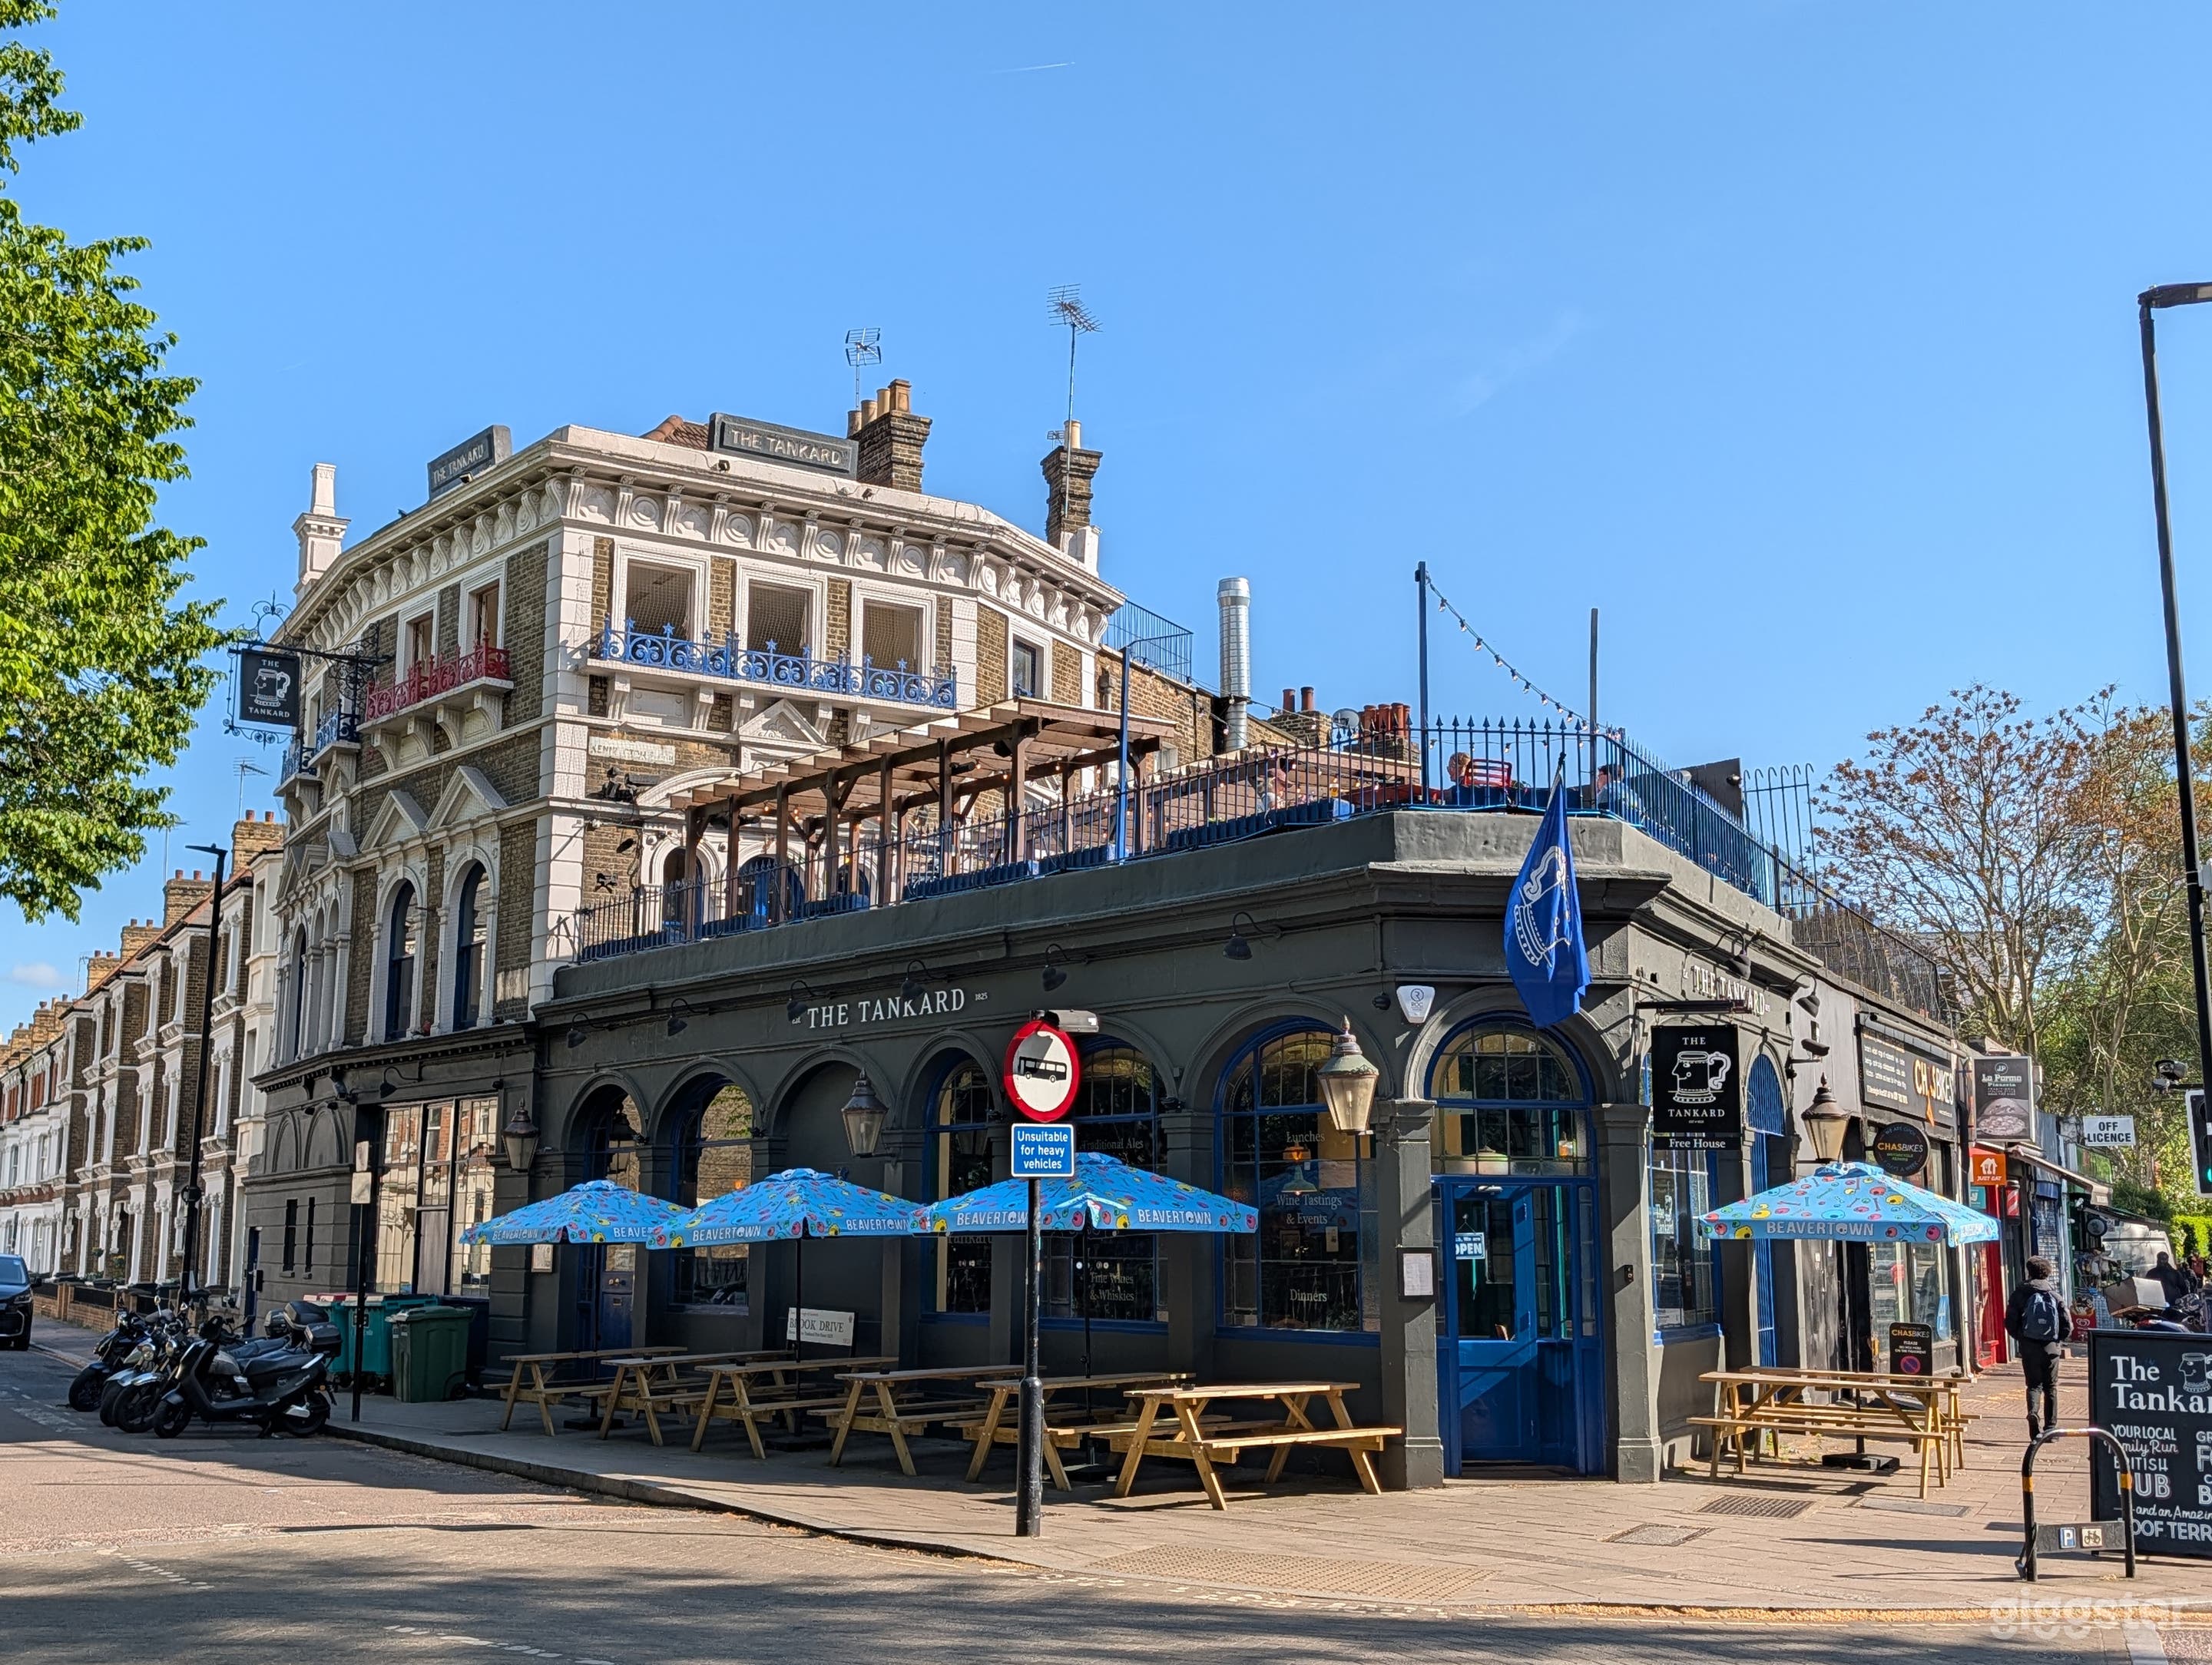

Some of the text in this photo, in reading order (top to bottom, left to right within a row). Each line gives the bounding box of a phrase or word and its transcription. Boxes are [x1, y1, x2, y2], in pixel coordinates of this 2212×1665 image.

[731, 429, 842, 465] THE TANKARD
[433, 444, 484, 486] THE TANKARD
[261, 659, 280, 668] THE
[248, 707, 290, 718] TANKARD
[1694, 965, 1764, 1015] THE TANKARD
[807, 1004, 849, 1028] THE
[858, 988, 965, 1023] TANKARD
[1682, 1037, 1706, 1045] THE
[1668, 1108, 1725, 1117] TANKARD
[2098, 1121, 2118, 1131] OFF
[1017, 1130, 1068, 1142] Unsuitable
[1286, 1130, 1326, 1143] Lunches
[2087, 1133, 2132, 1143] LICENCE
[1126, 1137, 1144, 1149] Ales
[1669, 1138, 1726, 1148] Free House
[1877, 1142, 1923, 1153] CHASBIKES
[1021, 1144, 1065, 1157] for heavy
[1024, 1158, 1061, 1170] vehicles
[1276, 1194, 1343, 1210] Wine Tastings
[956, 1211, 1028, 1226] BEAVERTOW
[1137, 1209, 1212, 1225] BEAVERTOWN
[1286, 1213, 1328, 1224] & Events
[846, 1218, 909, 1231] BEAVERTOWN
[1767, 1221, 1874, 1236] BEAVERTOWN
[692, 1225, 761, 1242] BEAVERTOWN
[1098, 1289, 1135, 1302] Whiskies
[1290, 1289, 1328, 1303] Dinners
[820, 1320, 845, 1333] DRIVE
[1891, 1329, 1930, 1339] CHASBIKES
[2110, 1356, 2161, 1382] The
[2111, 1424, 2177, 1441] YOUR LOCAL
[2104, 1438, 2178, 1457] mily Run
[2114, 1455, 2168, 1471] BITISH
[2136, 1504, 2157, 1516] and
[2158, 1508, 2172, 1518] an
[2118, 1518, 2164, 1538] OOF
[2064, 1528, 2073, 1546] P
